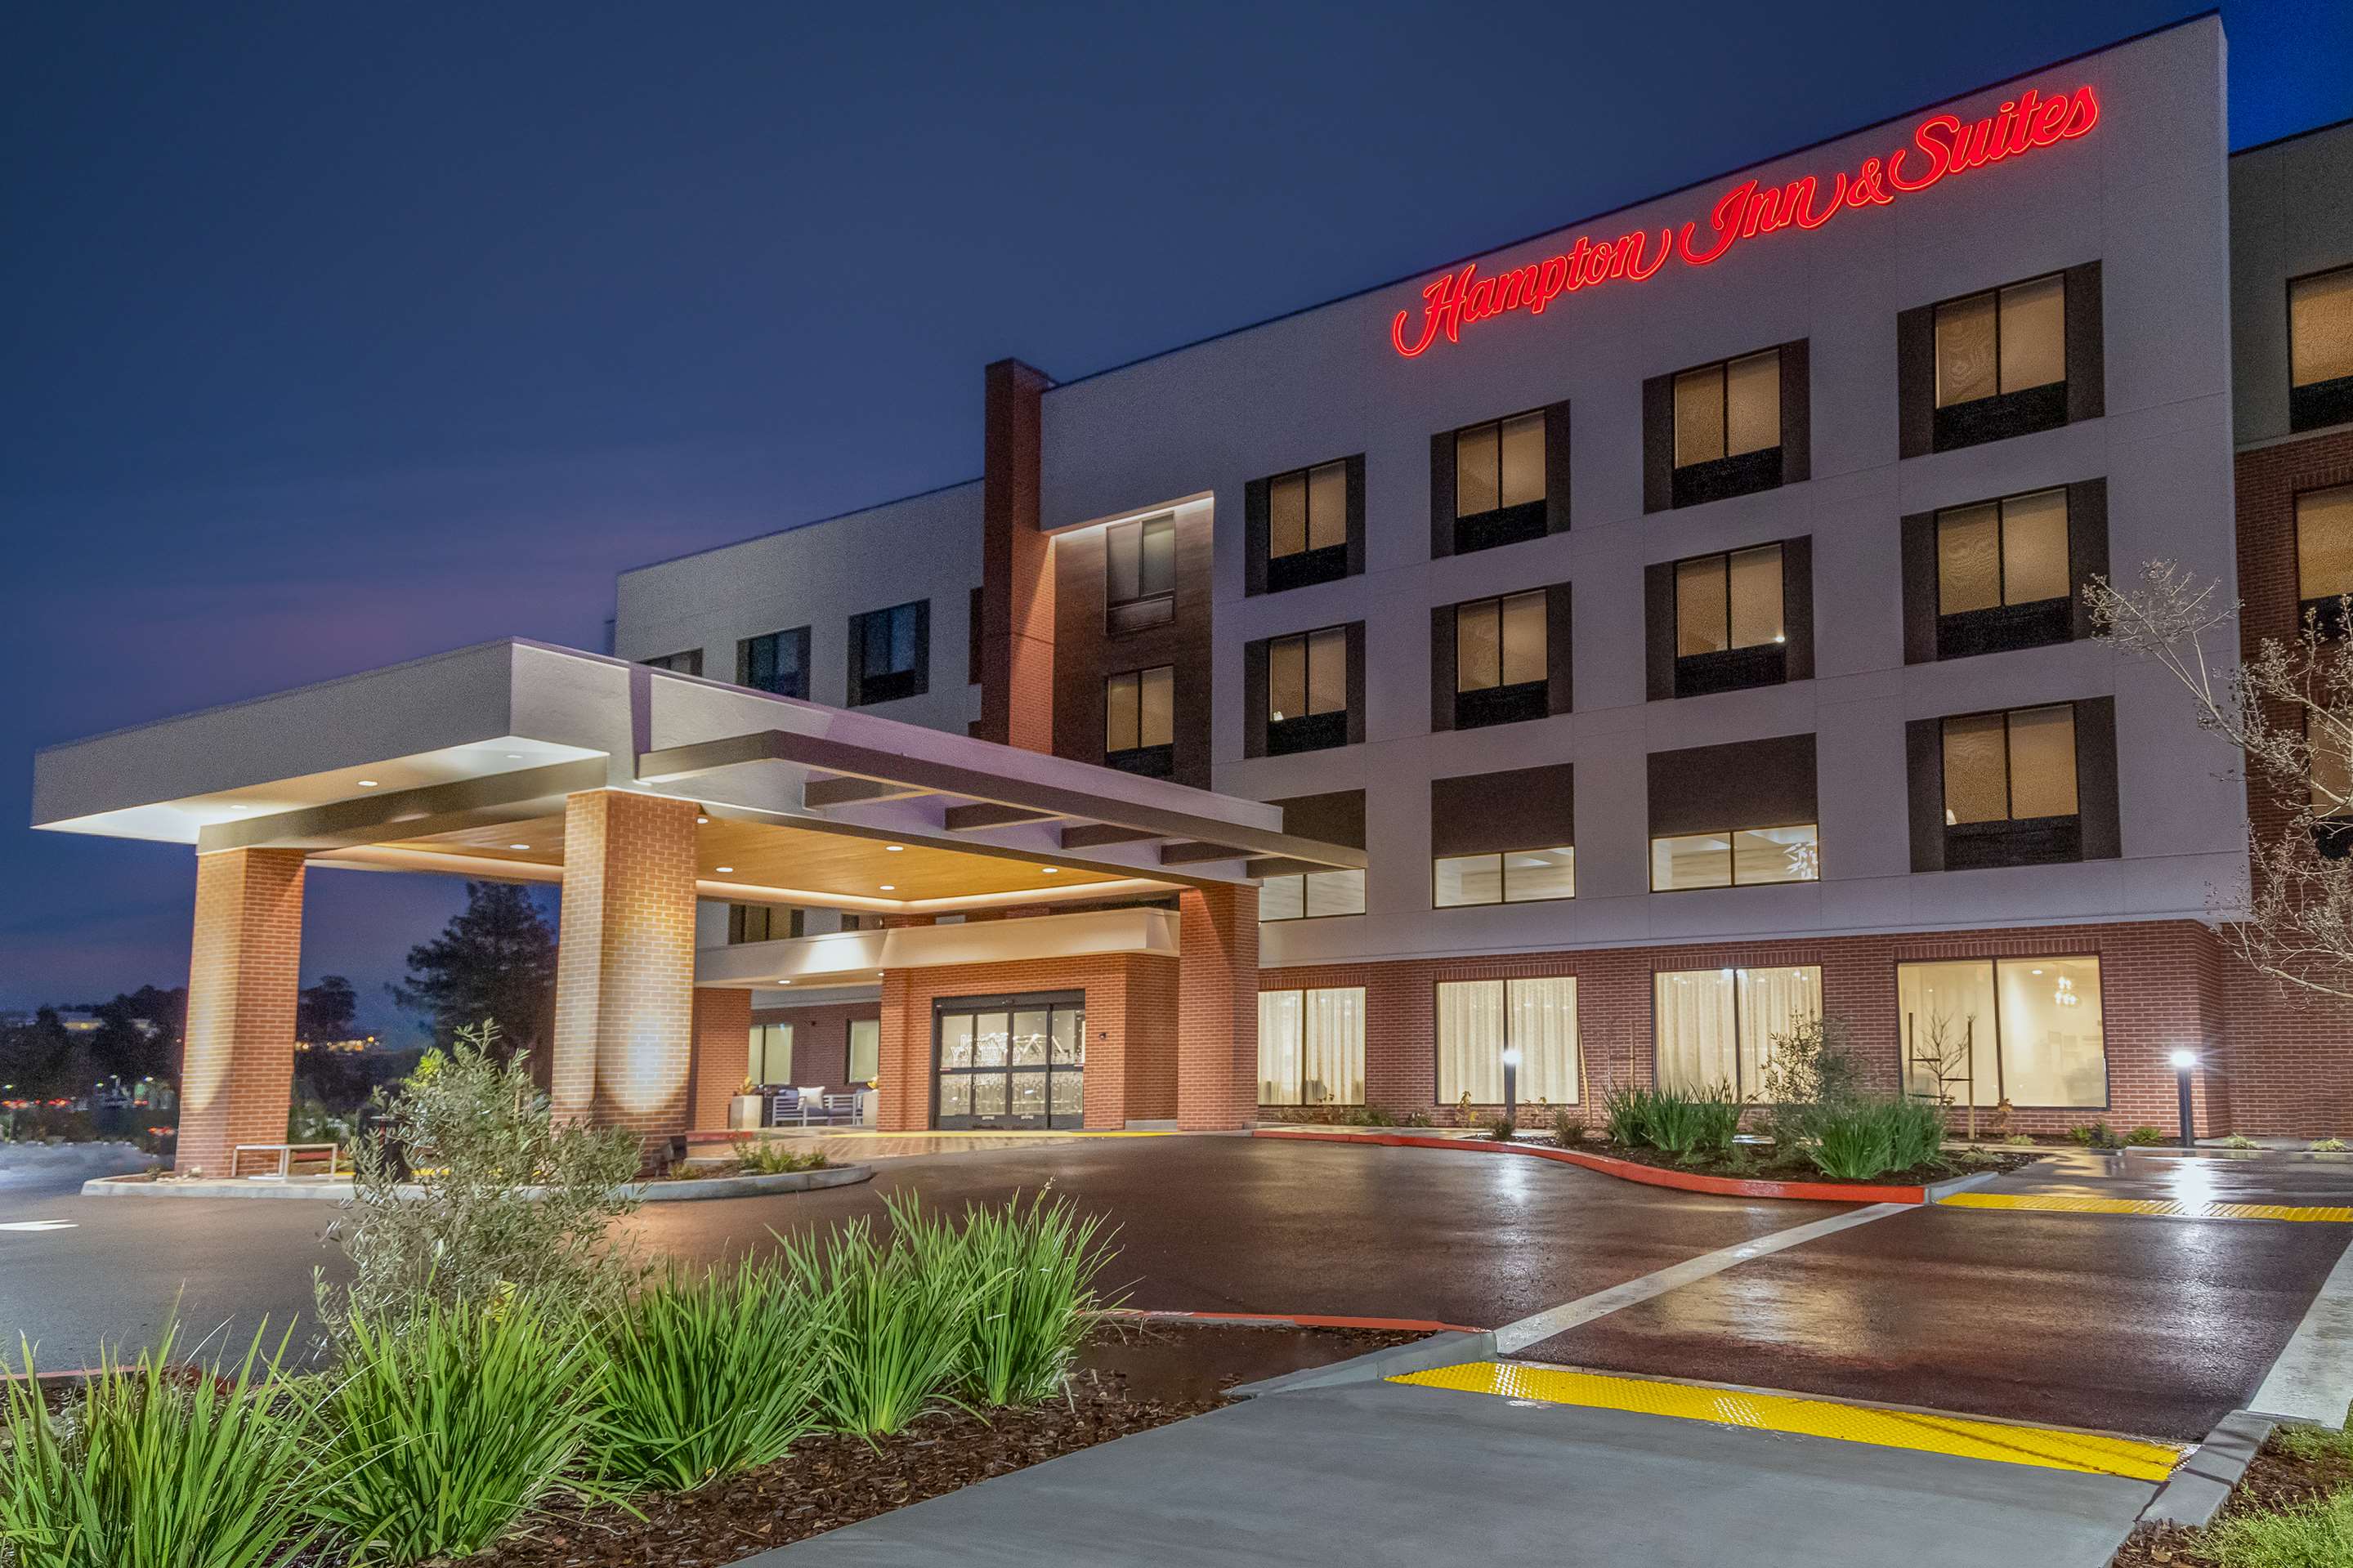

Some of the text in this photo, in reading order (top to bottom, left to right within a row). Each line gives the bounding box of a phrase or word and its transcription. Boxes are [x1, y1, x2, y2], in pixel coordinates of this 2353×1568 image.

[1393, 85, 2098, 357] Hampton Inn & Suites
